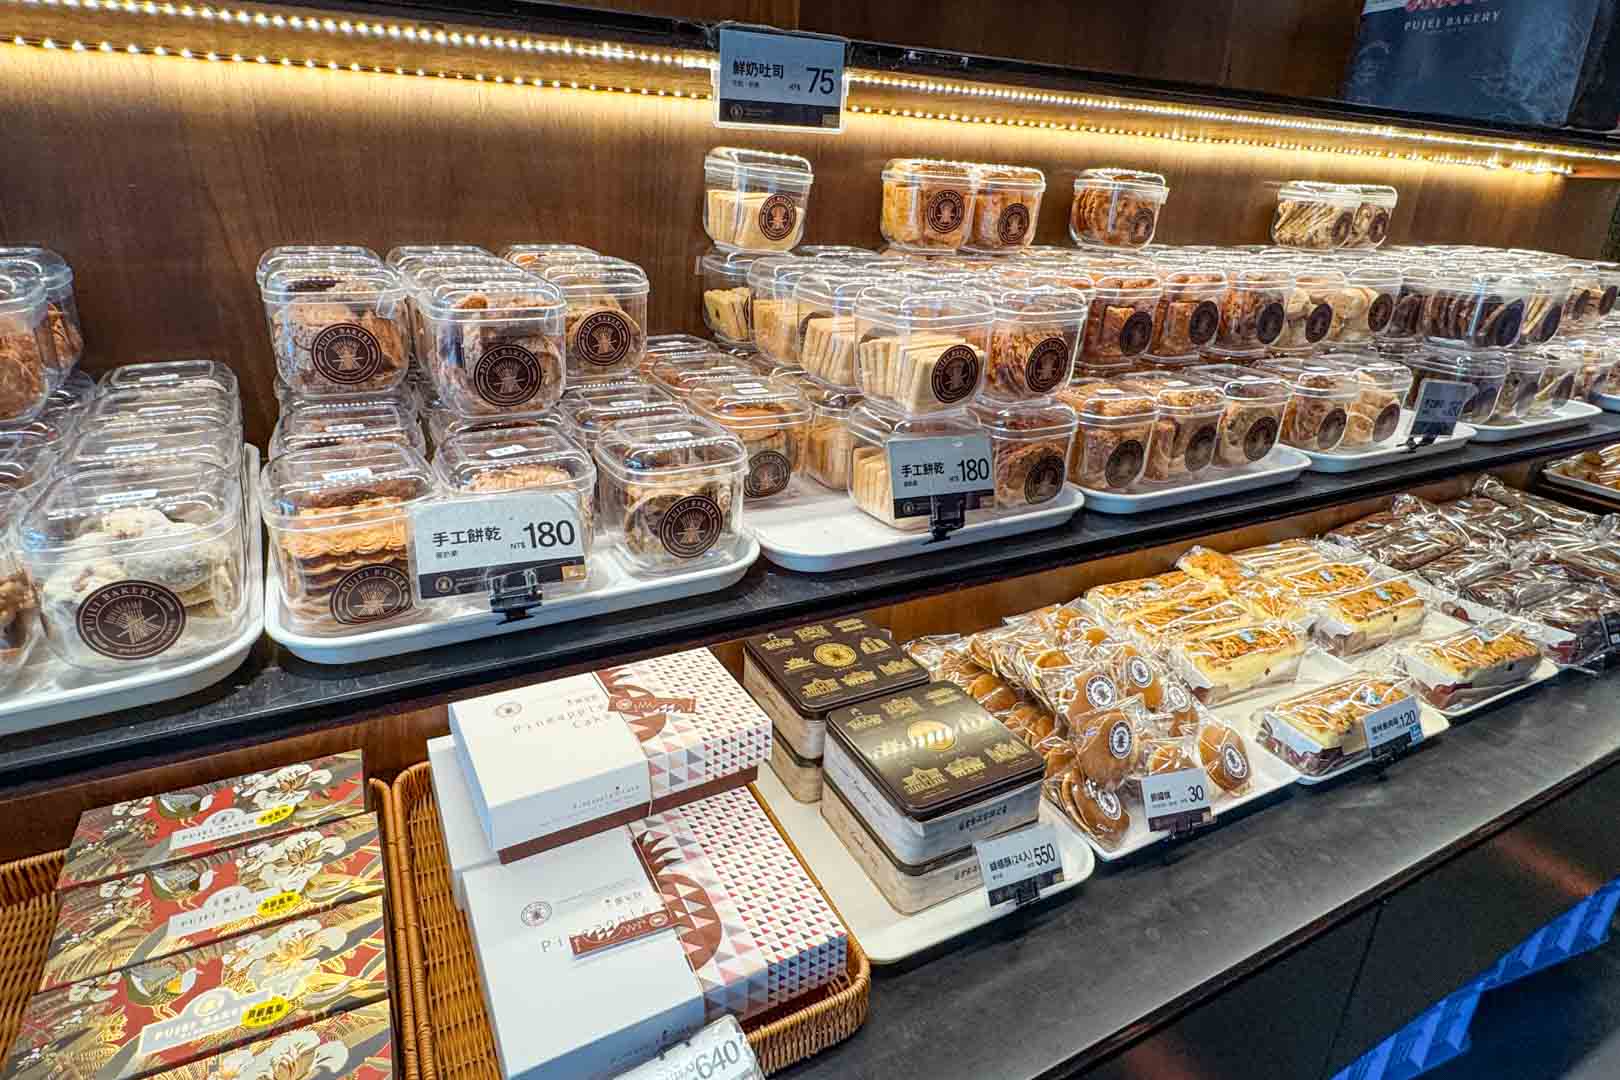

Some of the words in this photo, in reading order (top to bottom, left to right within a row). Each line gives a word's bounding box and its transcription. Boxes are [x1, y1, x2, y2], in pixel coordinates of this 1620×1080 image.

[1445, 9, 1503, 27] BAKERY
[733, 60, 784, 80] 鮮奶吐司
[806, 66, 835, 95] 75
[339, 327, 372, 346] BAKERY
[901, 462, 945, 478] 手工餅乾
[957, 458, 990, 481] 180
[432, 526, 502, 548] 手工餅乾
[510, 541, 526, 551] NT$
[522, 519, 575, 549] 180
[101, 586, 160, 602] BAKERY
[1400, 709, 1416, 728] 120
[1188, 784, 1204, 802] 30
[1033, 843, 1056, 866] 550
[695, 1039, 740, 1080] 640
